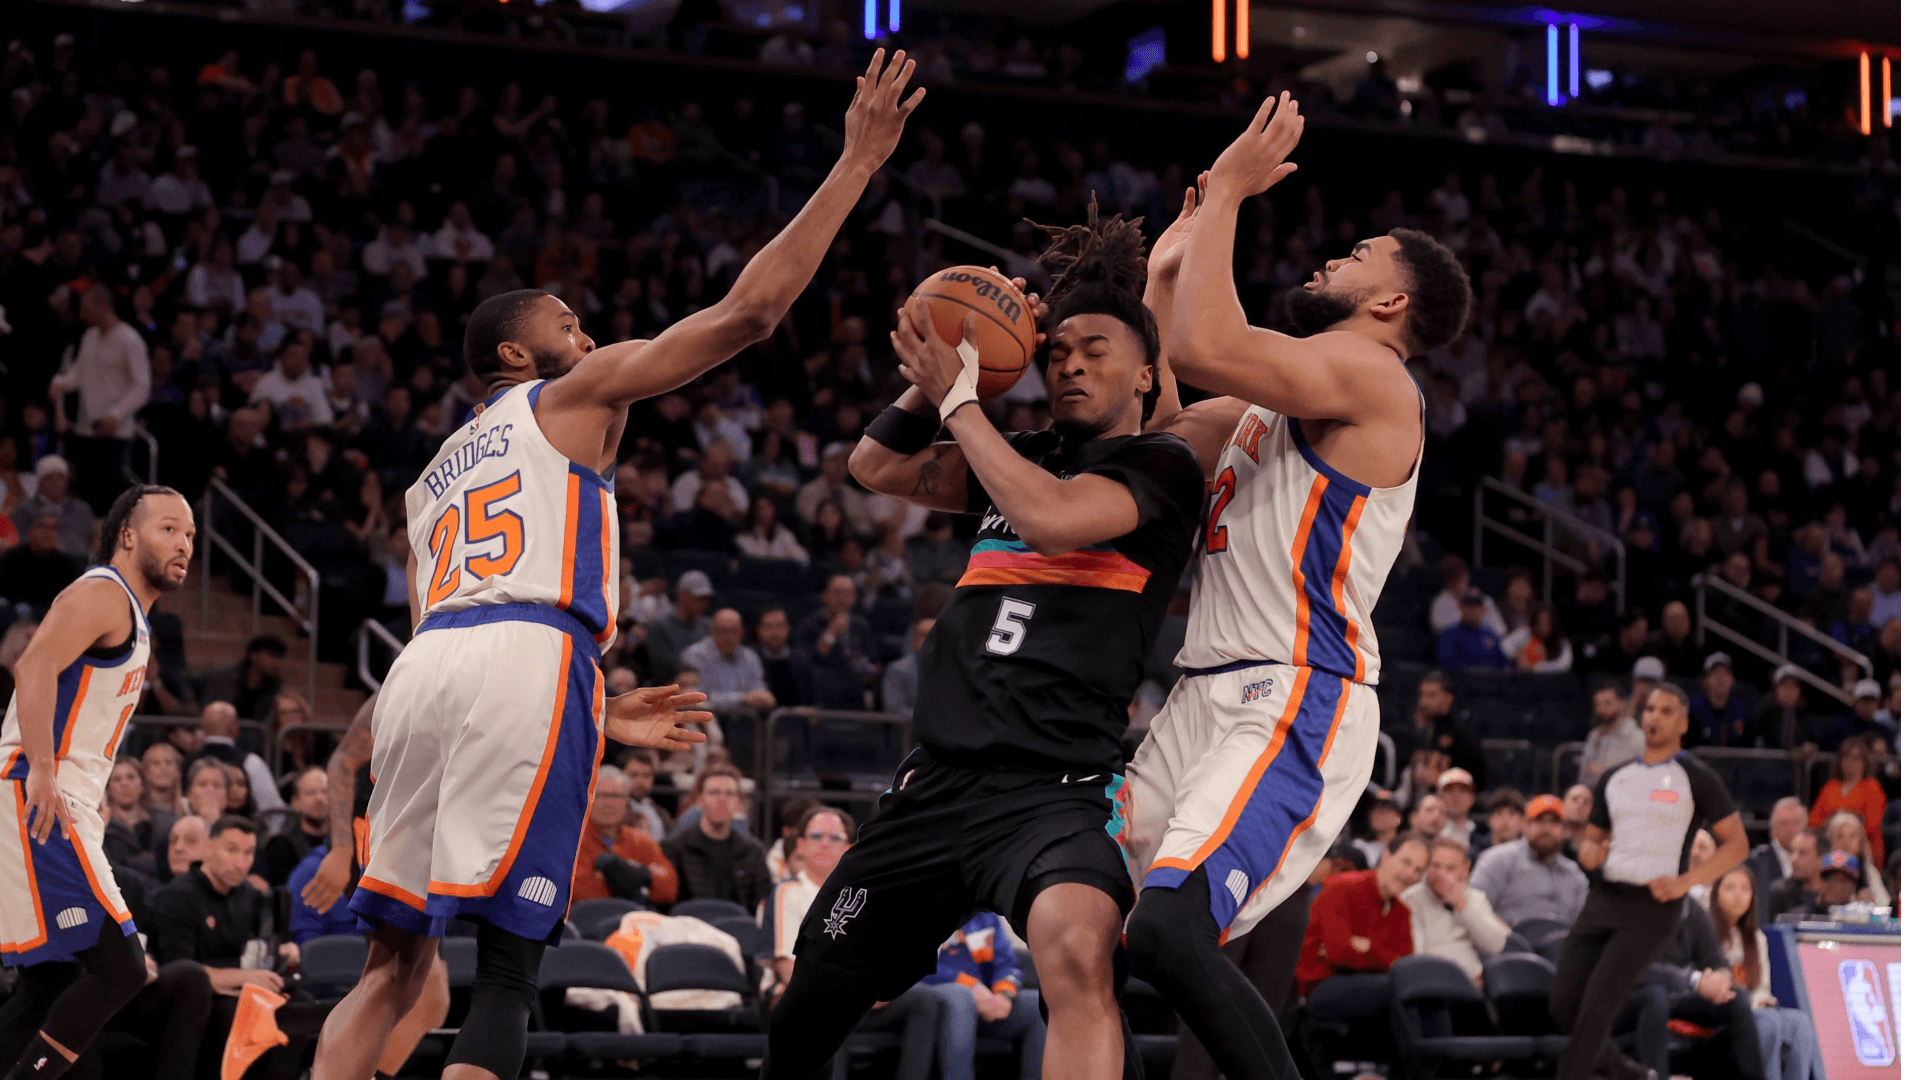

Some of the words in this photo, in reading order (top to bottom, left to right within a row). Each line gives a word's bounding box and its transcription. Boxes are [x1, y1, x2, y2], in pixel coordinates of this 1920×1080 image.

[940, 272, 1021, 326] Wilson
[424, 423, 513, 501] BRIDGES
[426, 468, 525, 611] 25
[985, 595, 1036, 656] 5
[1241, 678, 1274, 705] NYC
